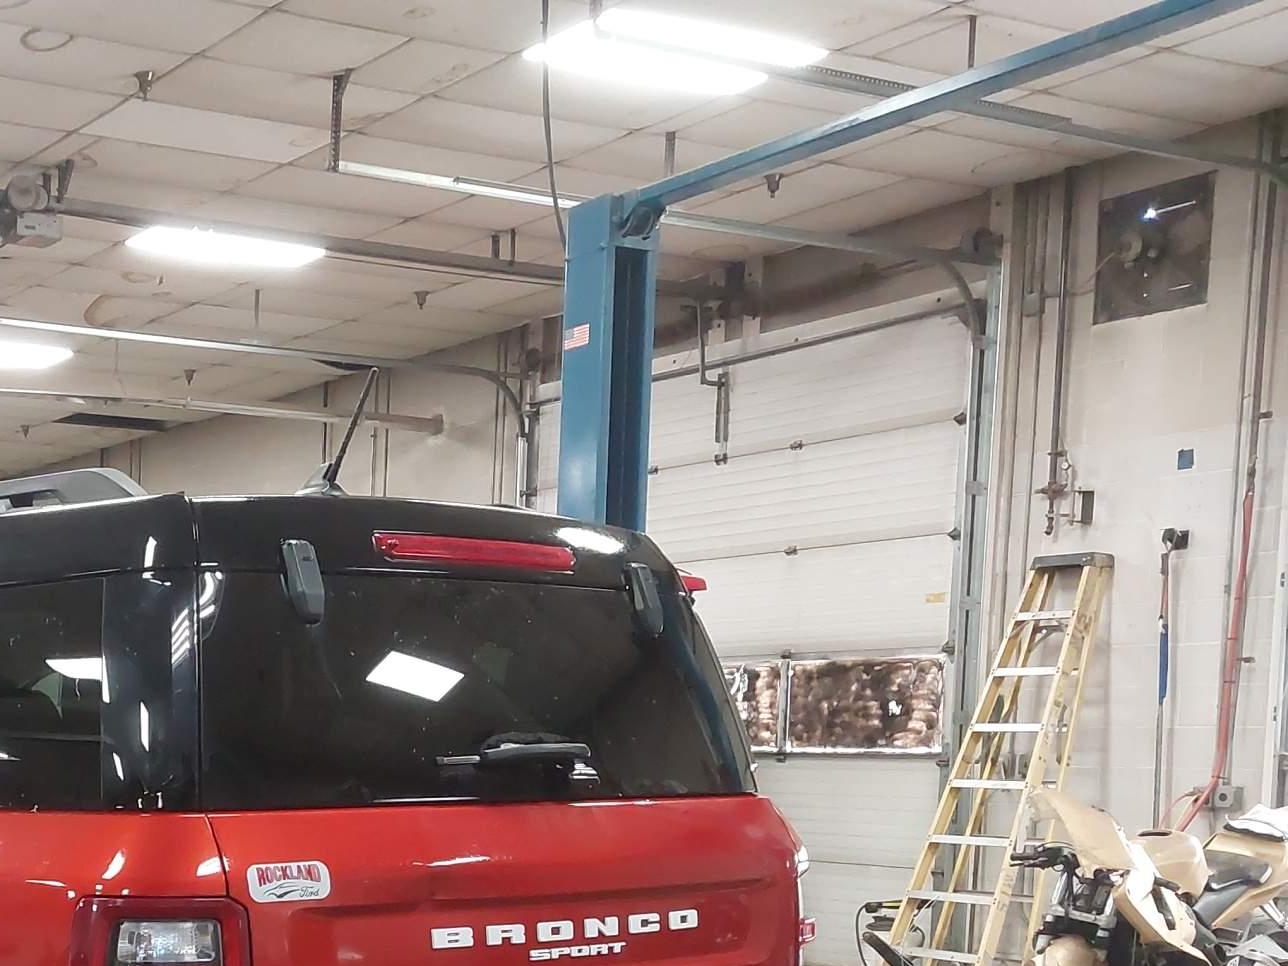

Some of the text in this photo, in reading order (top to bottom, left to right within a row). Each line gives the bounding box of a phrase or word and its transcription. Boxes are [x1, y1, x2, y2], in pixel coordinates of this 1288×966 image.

[256, 864, 321, 887] ROCKLAND
[300, 887, 319, 897] Ford
[431, 909, 699, 949] BRONCO
[529, 942, 627, 961] SPORT
